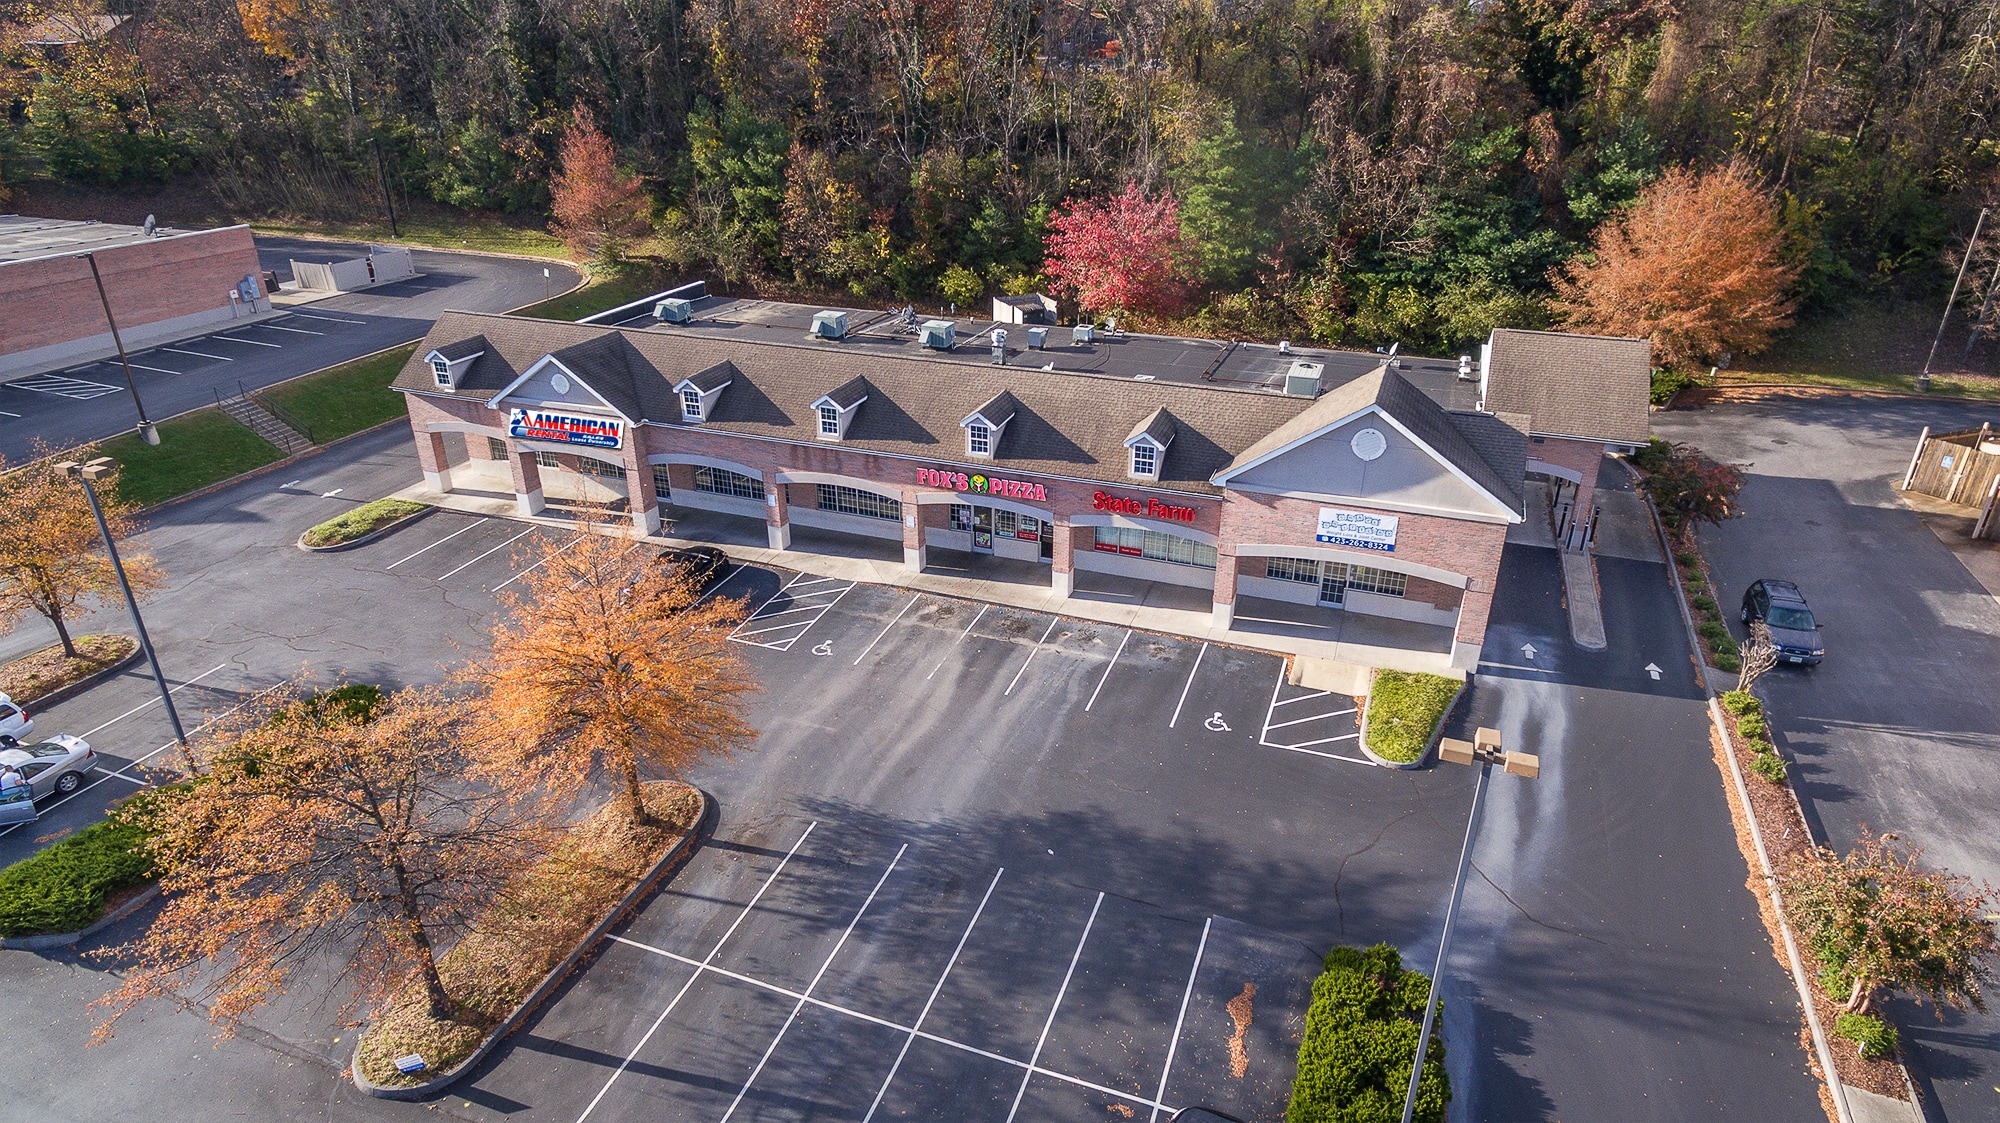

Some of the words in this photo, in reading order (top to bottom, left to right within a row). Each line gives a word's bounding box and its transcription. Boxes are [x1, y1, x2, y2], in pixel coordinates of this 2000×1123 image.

[526, 428, 571, 441] RENTAL
[533, 413, 619, 437] AMERICAN
[916, 468, 969, 491] FOX'S
[988, 478, 1047, 502] PIZZA
[1093, 491, 1142, 516] State
[1147, 498, 1195, 523] Farm
[1330, 537, 1389, 551] 423-262-8324
